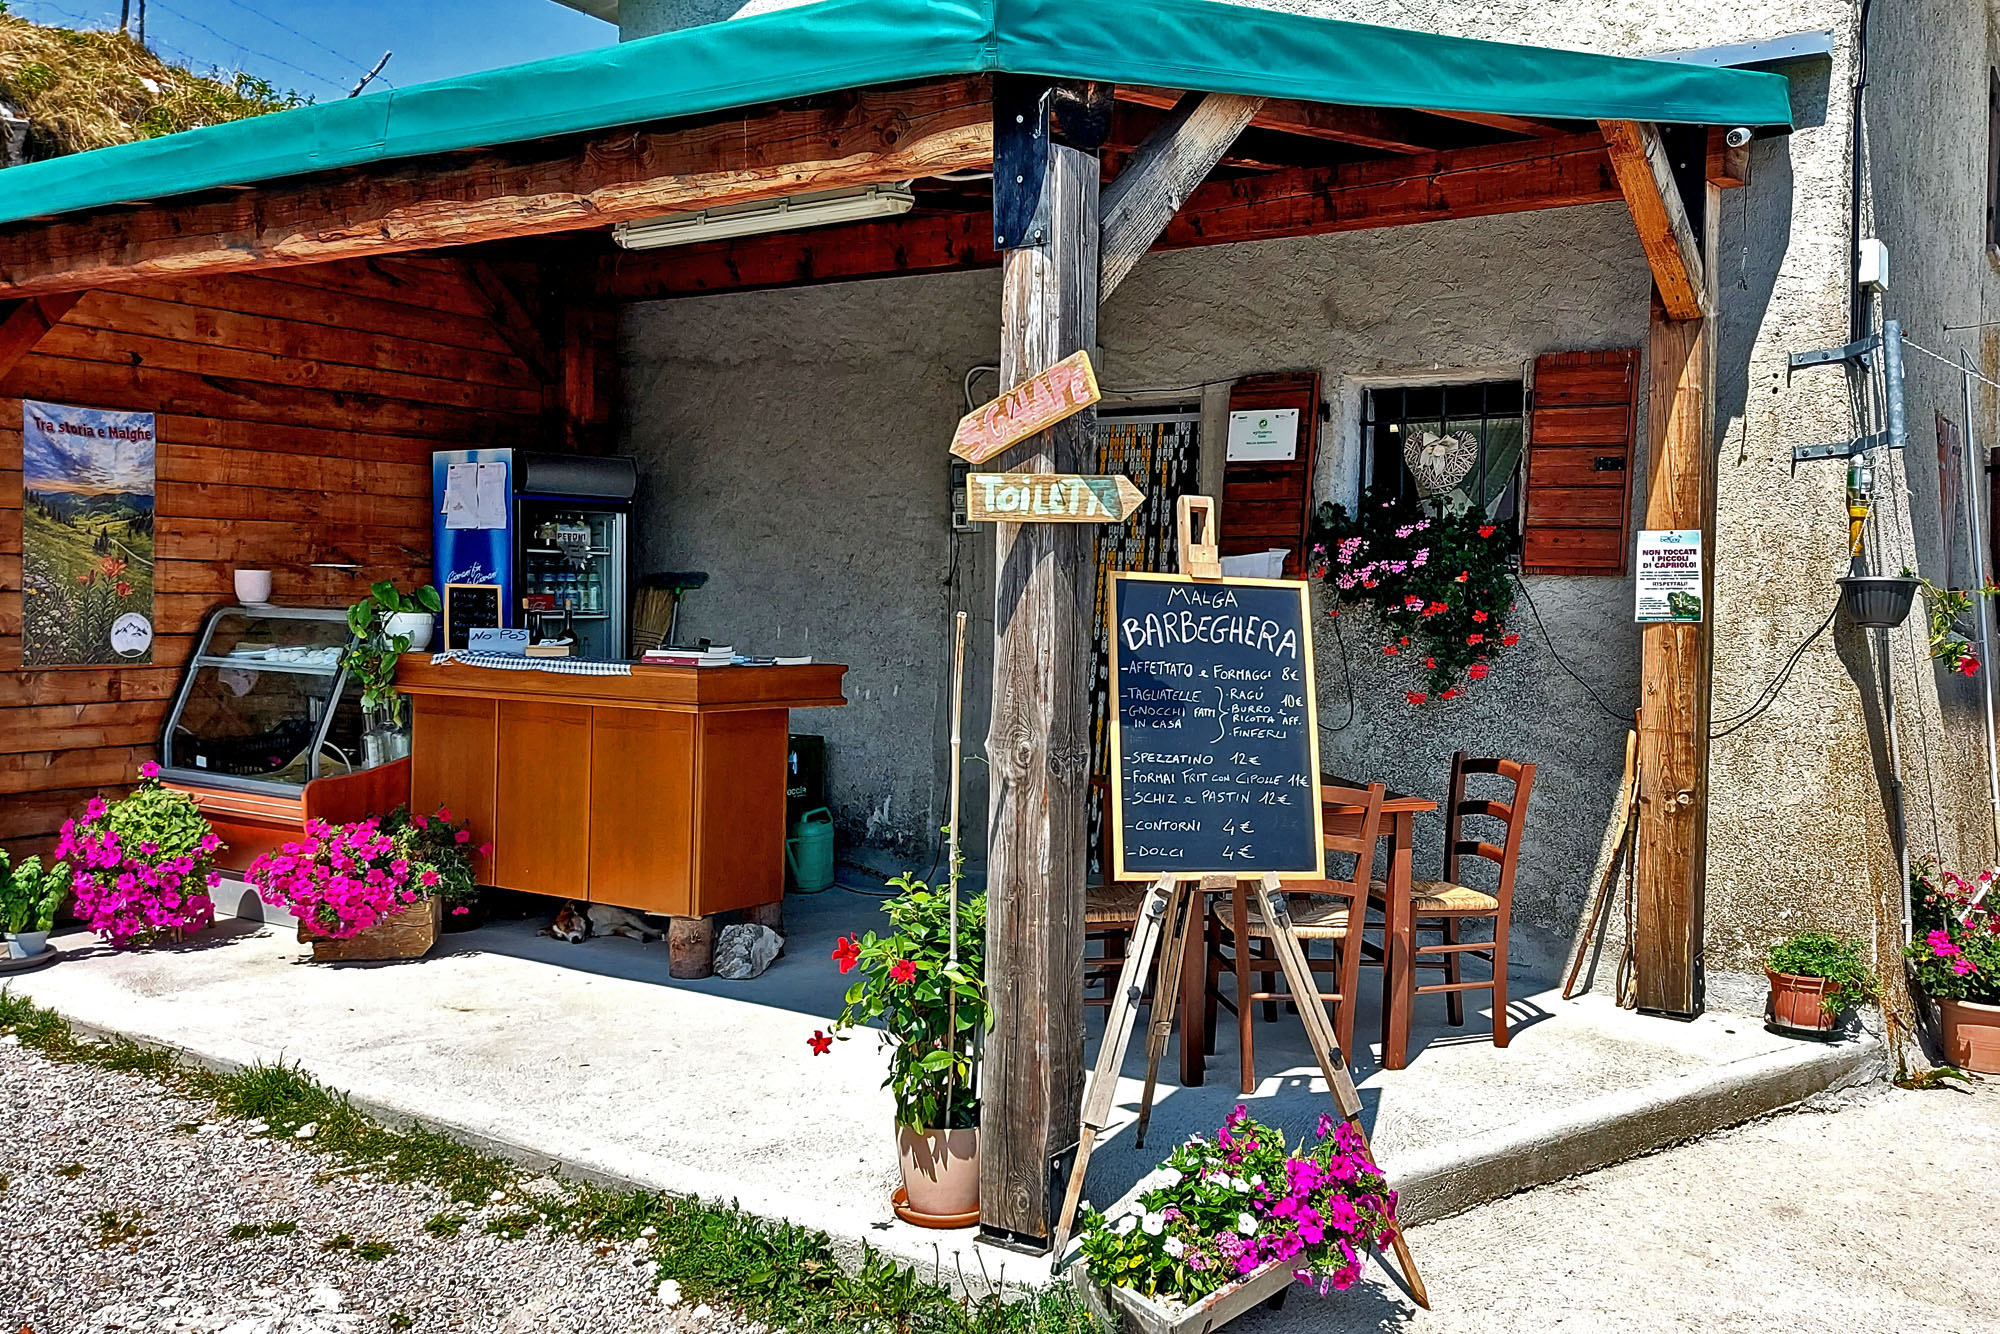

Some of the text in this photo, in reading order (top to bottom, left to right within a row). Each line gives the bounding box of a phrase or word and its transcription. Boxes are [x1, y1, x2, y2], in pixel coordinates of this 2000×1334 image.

[33, 416, 152, 444] Tra storia e Malghe
[1663, 548, 1697, 556] TOCCATE
[1167, 587, 1238, 609] MALGA
[1122, 610, 1297, 659] BARBEGHERA
[1213, 664, 1271, 680] FORMAGGI
[1281, 666, 1300, 681] 8€
[1280, 694, 1304, 708] 10€
[1193, 706, 1216, 718] FATTI
[1231, 703, 1271, 714] BURRO
[1134, 719, 1182, 729] IN CASA
[1232, 713, 1301, 726] RICOTTA AFF.
[1233, 726, 1287, 739] FINFERLI
[1229, 752, 1262, 766] 12€
[1181, 768, 1208, 785] FRIT
[1235, 772, 1283, 785] CIPOLLE
[1202, 789, 1250, 805] PASTIN
[1258, 791, 1292, 805] 12€
